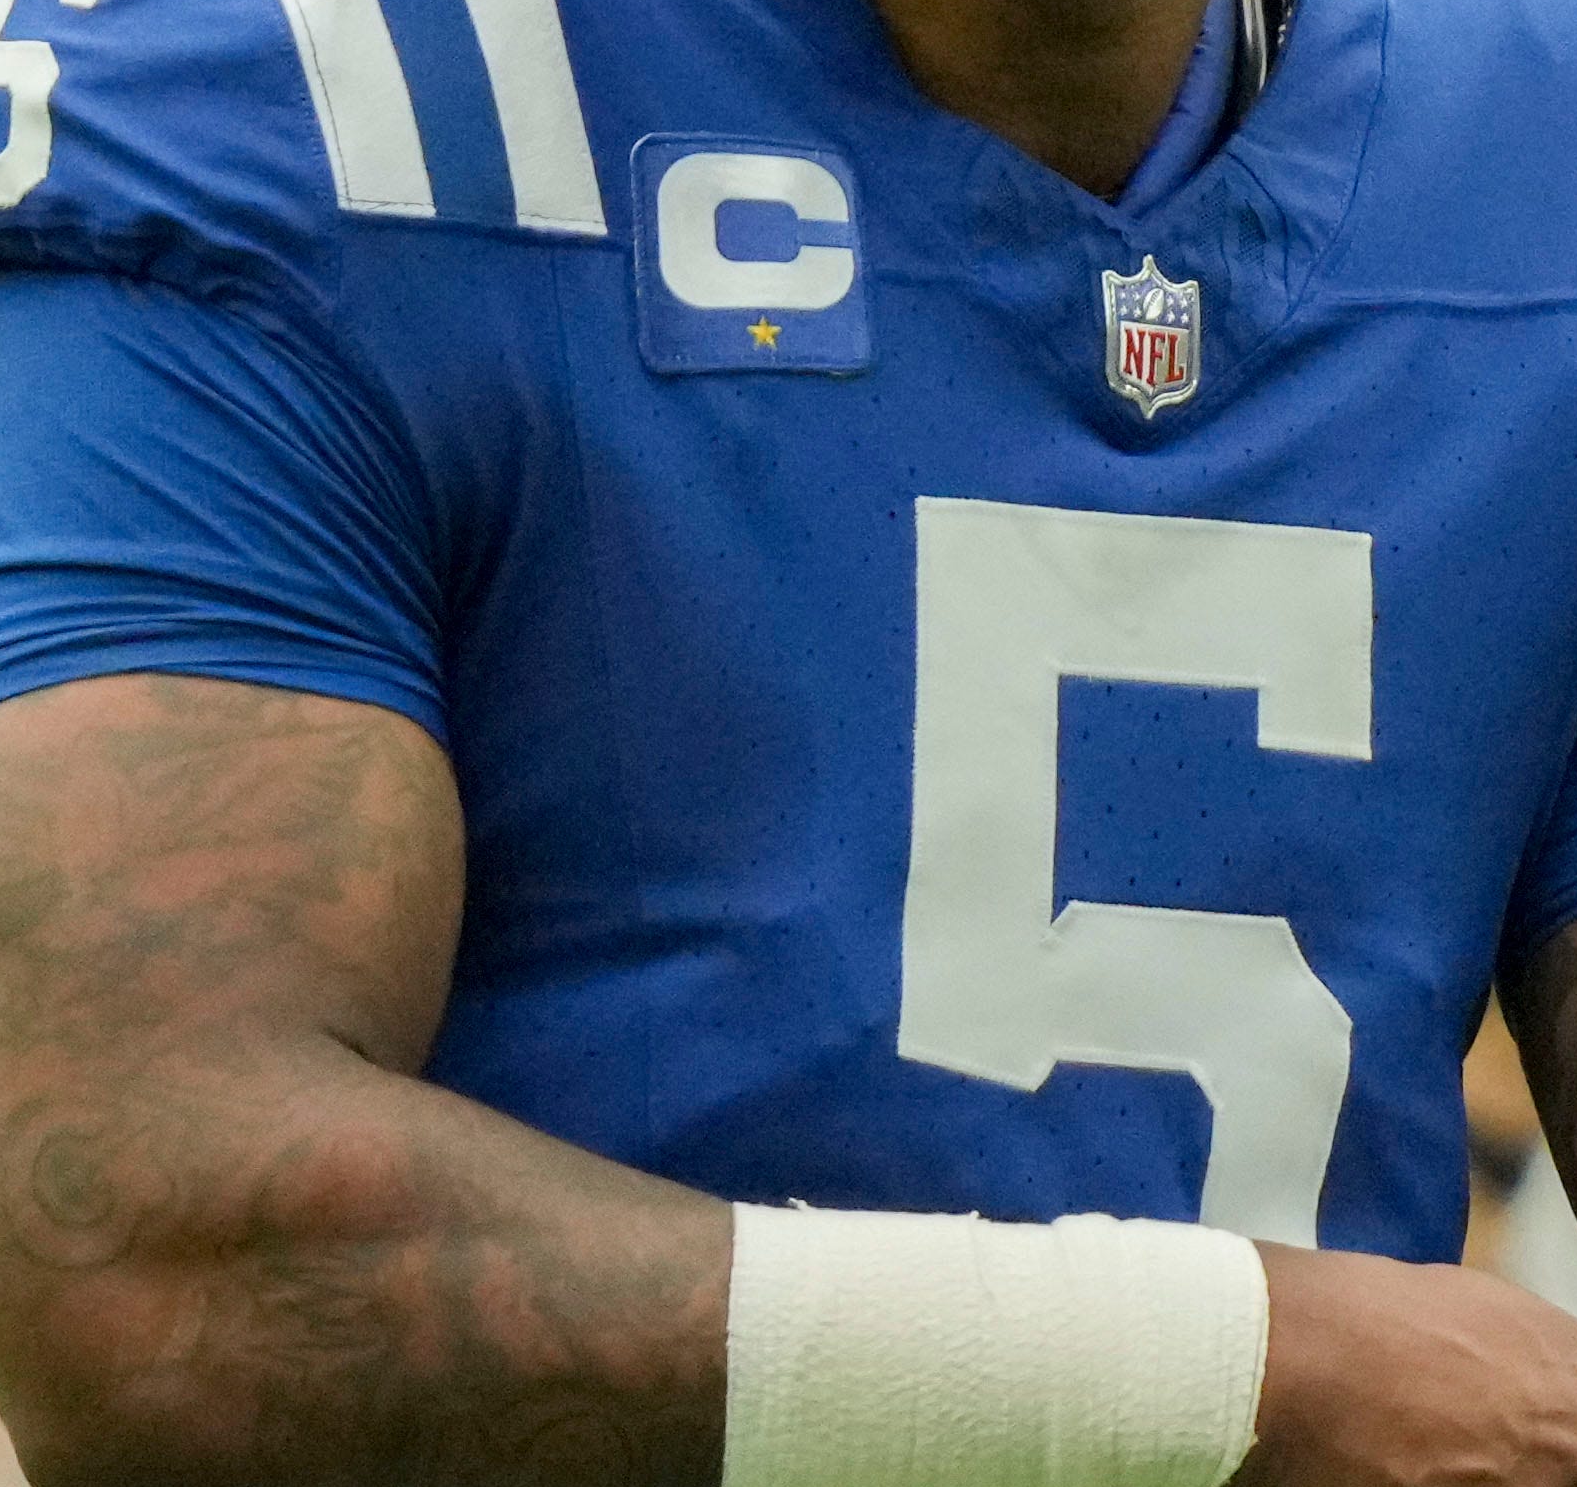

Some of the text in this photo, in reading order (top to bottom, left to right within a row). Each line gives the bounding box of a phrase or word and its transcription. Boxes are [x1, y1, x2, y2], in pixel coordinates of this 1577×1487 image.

[656, 151, 855, 311] C
[1122, 328, 1185, 387] NFL
[897, 495, 1373, 1250] 5
